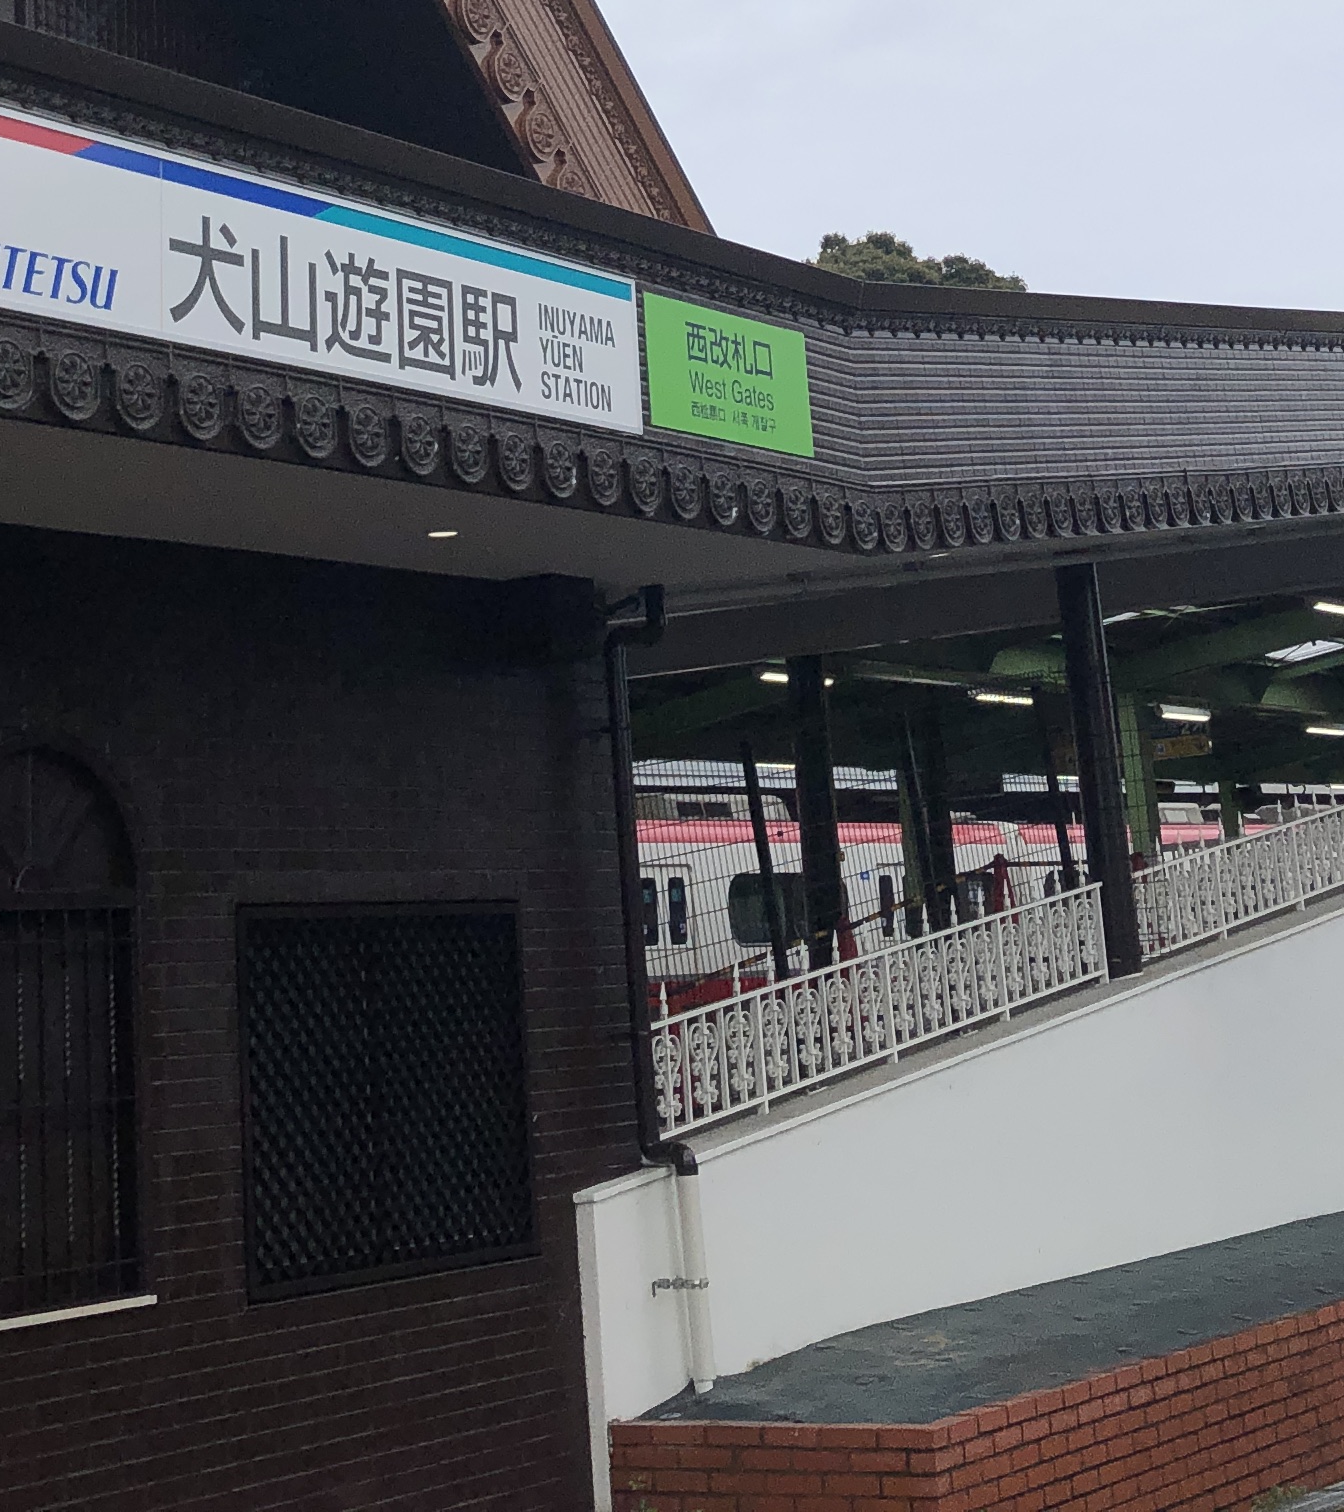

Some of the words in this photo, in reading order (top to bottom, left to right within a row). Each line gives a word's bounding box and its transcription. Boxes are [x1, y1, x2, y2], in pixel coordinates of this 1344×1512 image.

[169, 215, 522, 392] 犬山遊園駅
[537, 302, 616, 348] INUYAMA
[684, 320, 774, 380] 西改札口
[540, 370, 612, 412] STATION
[688, 368, 727, 400] West
[731, 379, 775, 411] Gates
